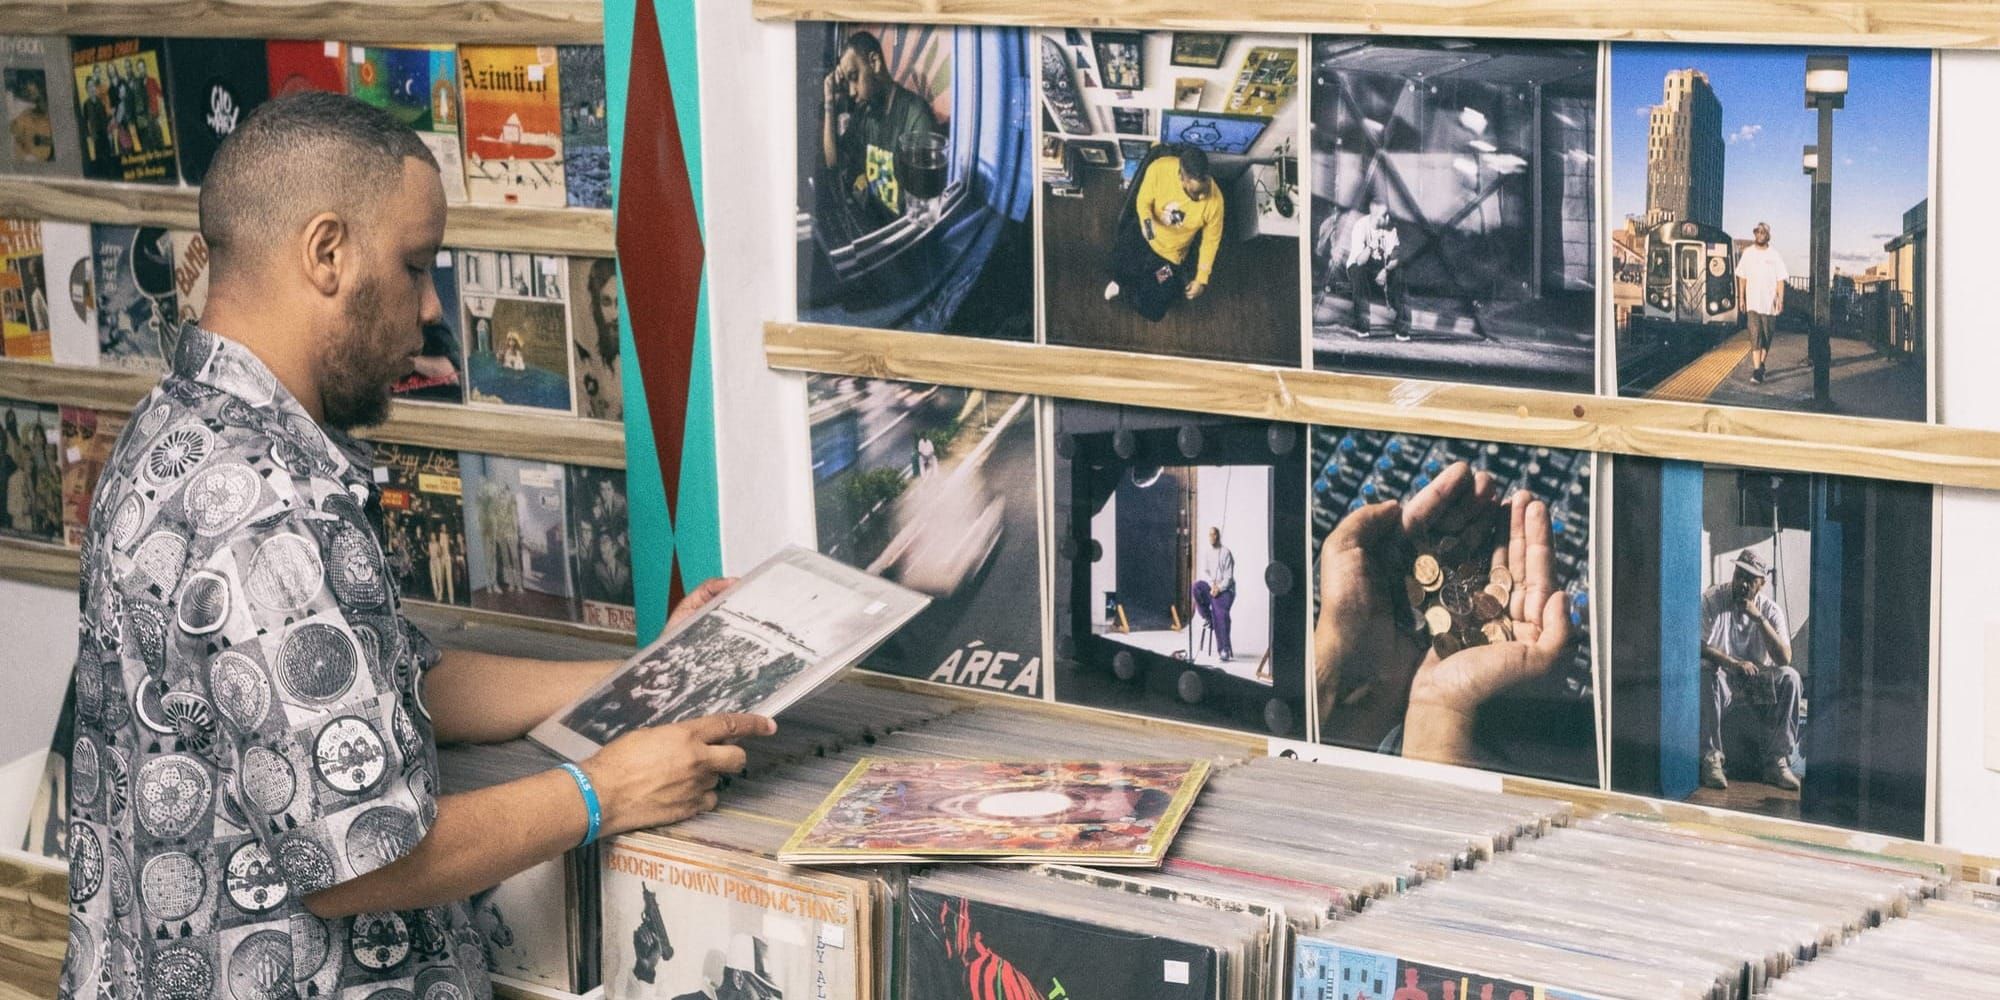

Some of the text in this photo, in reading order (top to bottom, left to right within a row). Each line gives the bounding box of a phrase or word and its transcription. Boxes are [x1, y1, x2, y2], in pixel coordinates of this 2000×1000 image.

[928, 639, 1041, 696] ÁREA
[607, 853, 849, 925] BOOGIE DOWN PRODUCTIONS
